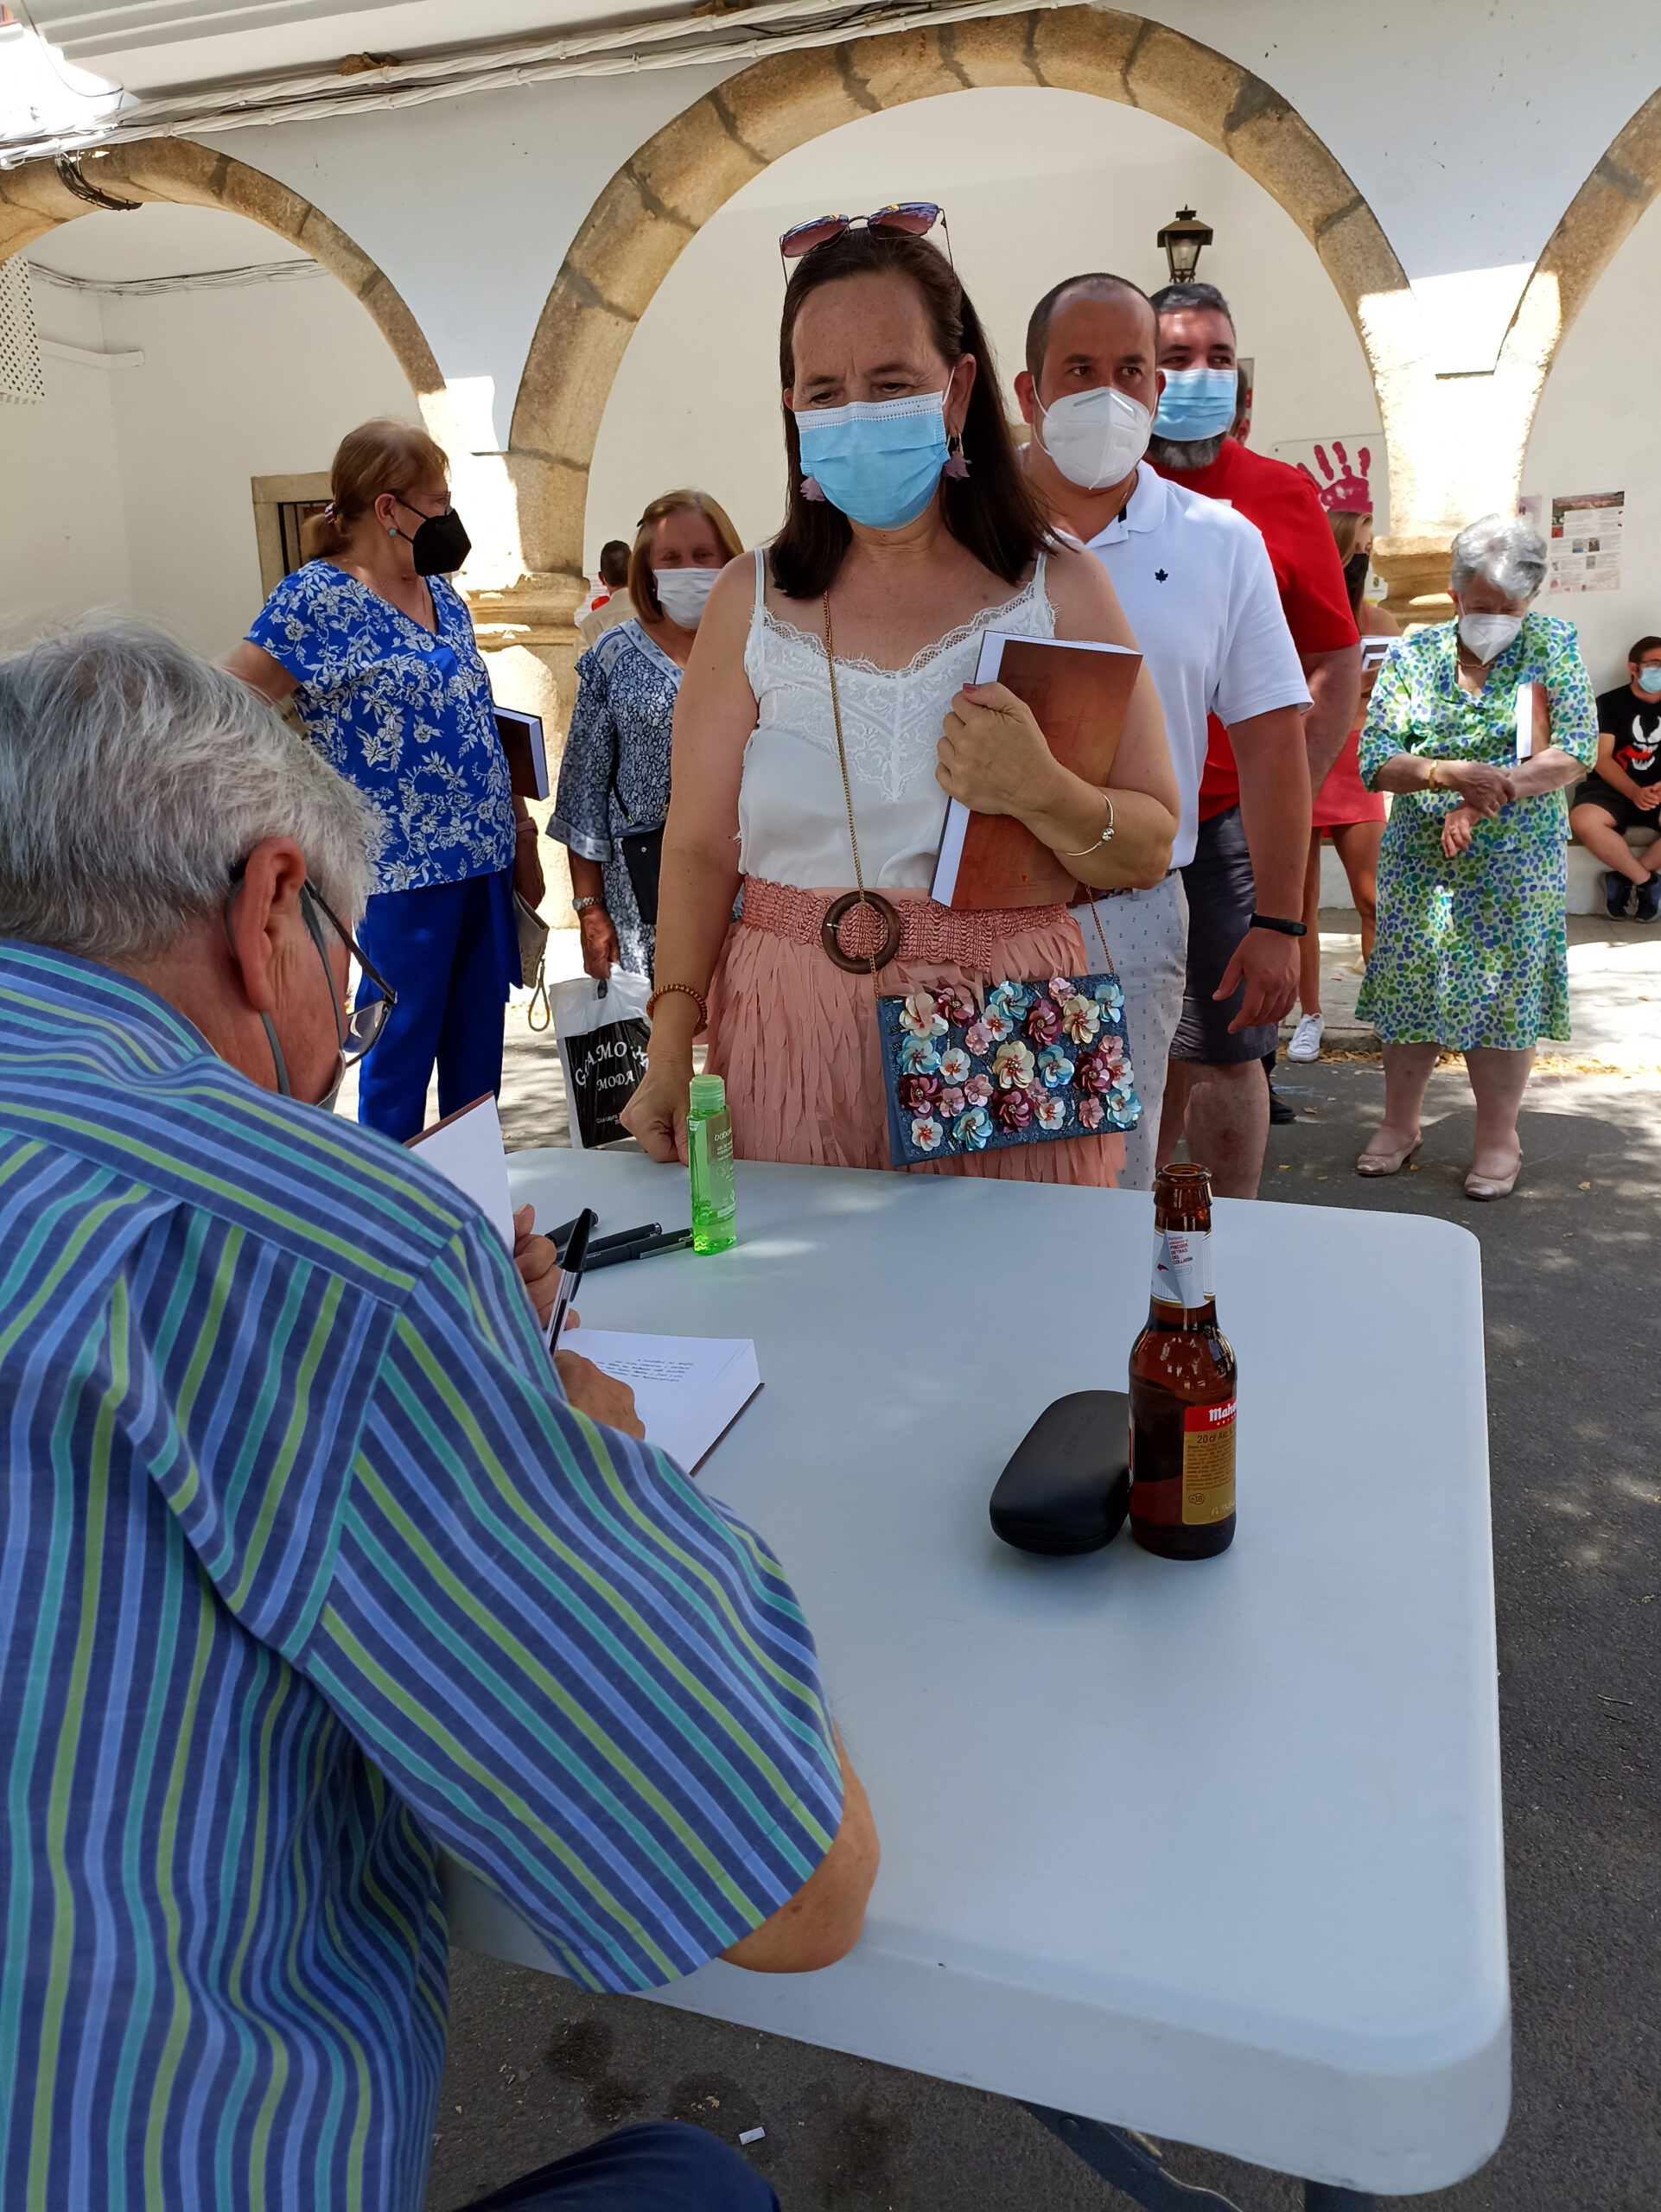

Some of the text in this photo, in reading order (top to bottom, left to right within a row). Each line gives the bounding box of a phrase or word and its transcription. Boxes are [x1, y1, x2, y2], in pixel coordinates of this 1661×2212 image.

[596, 1070, 635, 1091] MODA
[1197, 1434, 1208, 1444] 20
[1209, 1433, 1217, 1442] cl
